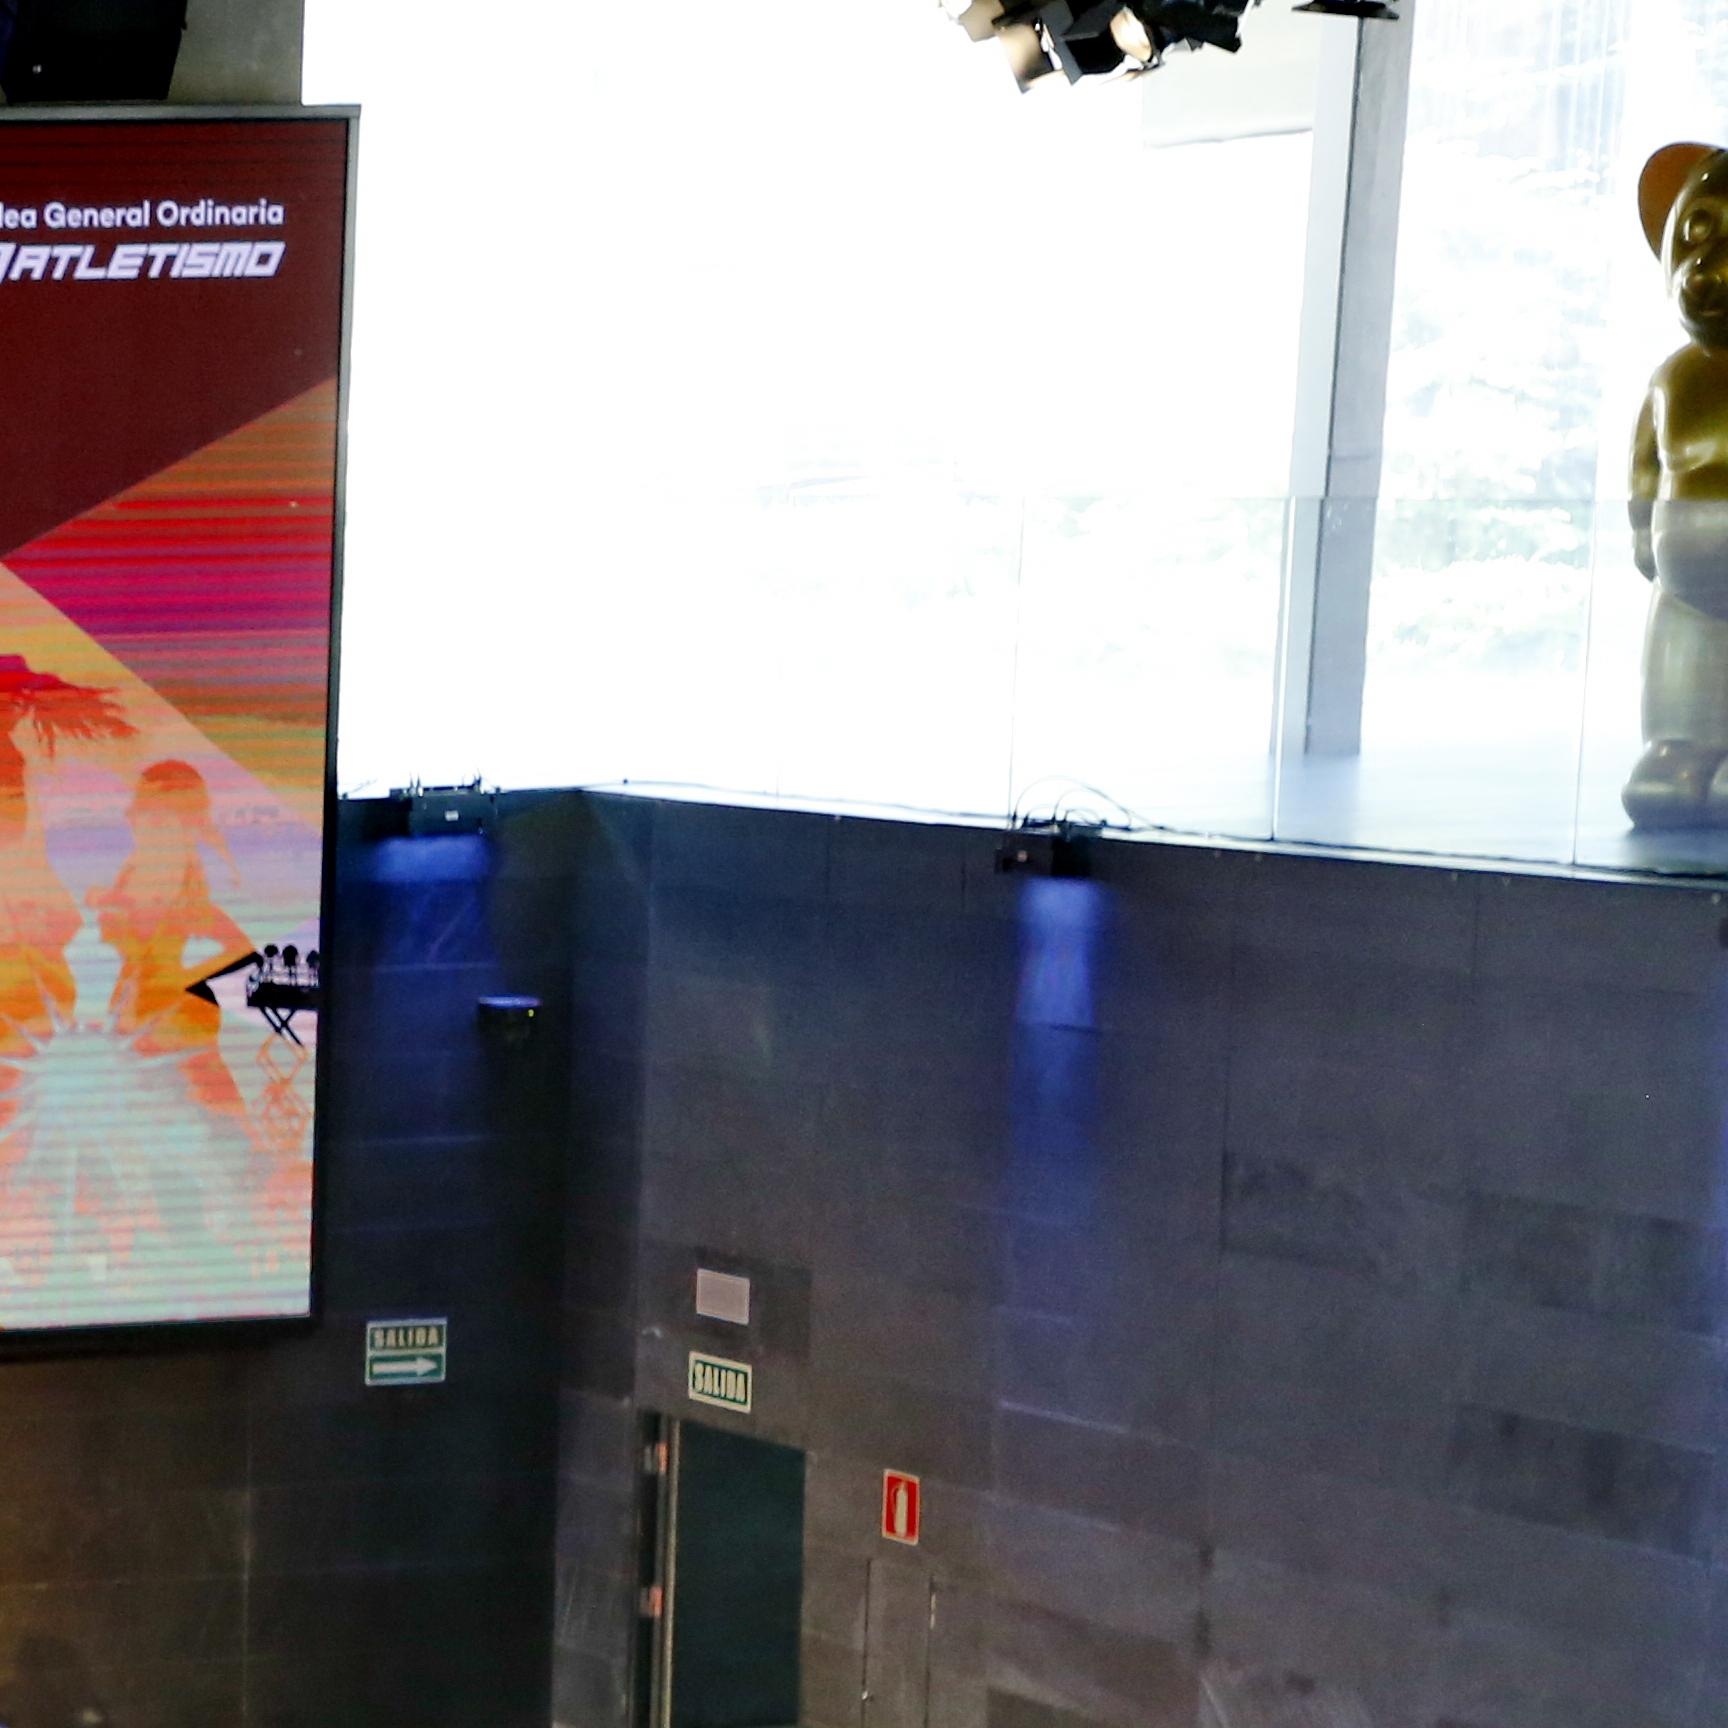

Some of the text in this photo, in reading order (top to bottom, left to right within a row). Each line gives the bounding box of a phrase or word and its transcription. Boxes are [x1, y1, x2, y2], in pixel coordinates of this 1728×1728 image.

[44, 200, 150, 228] General
[156, 197, 286, 227] Ordinaria
[8, 241, 287, 282] ATLETISMO
[372, 1325, 441, 1349] SALIDA
[692, 1361, 747, 1403] SALIDA
